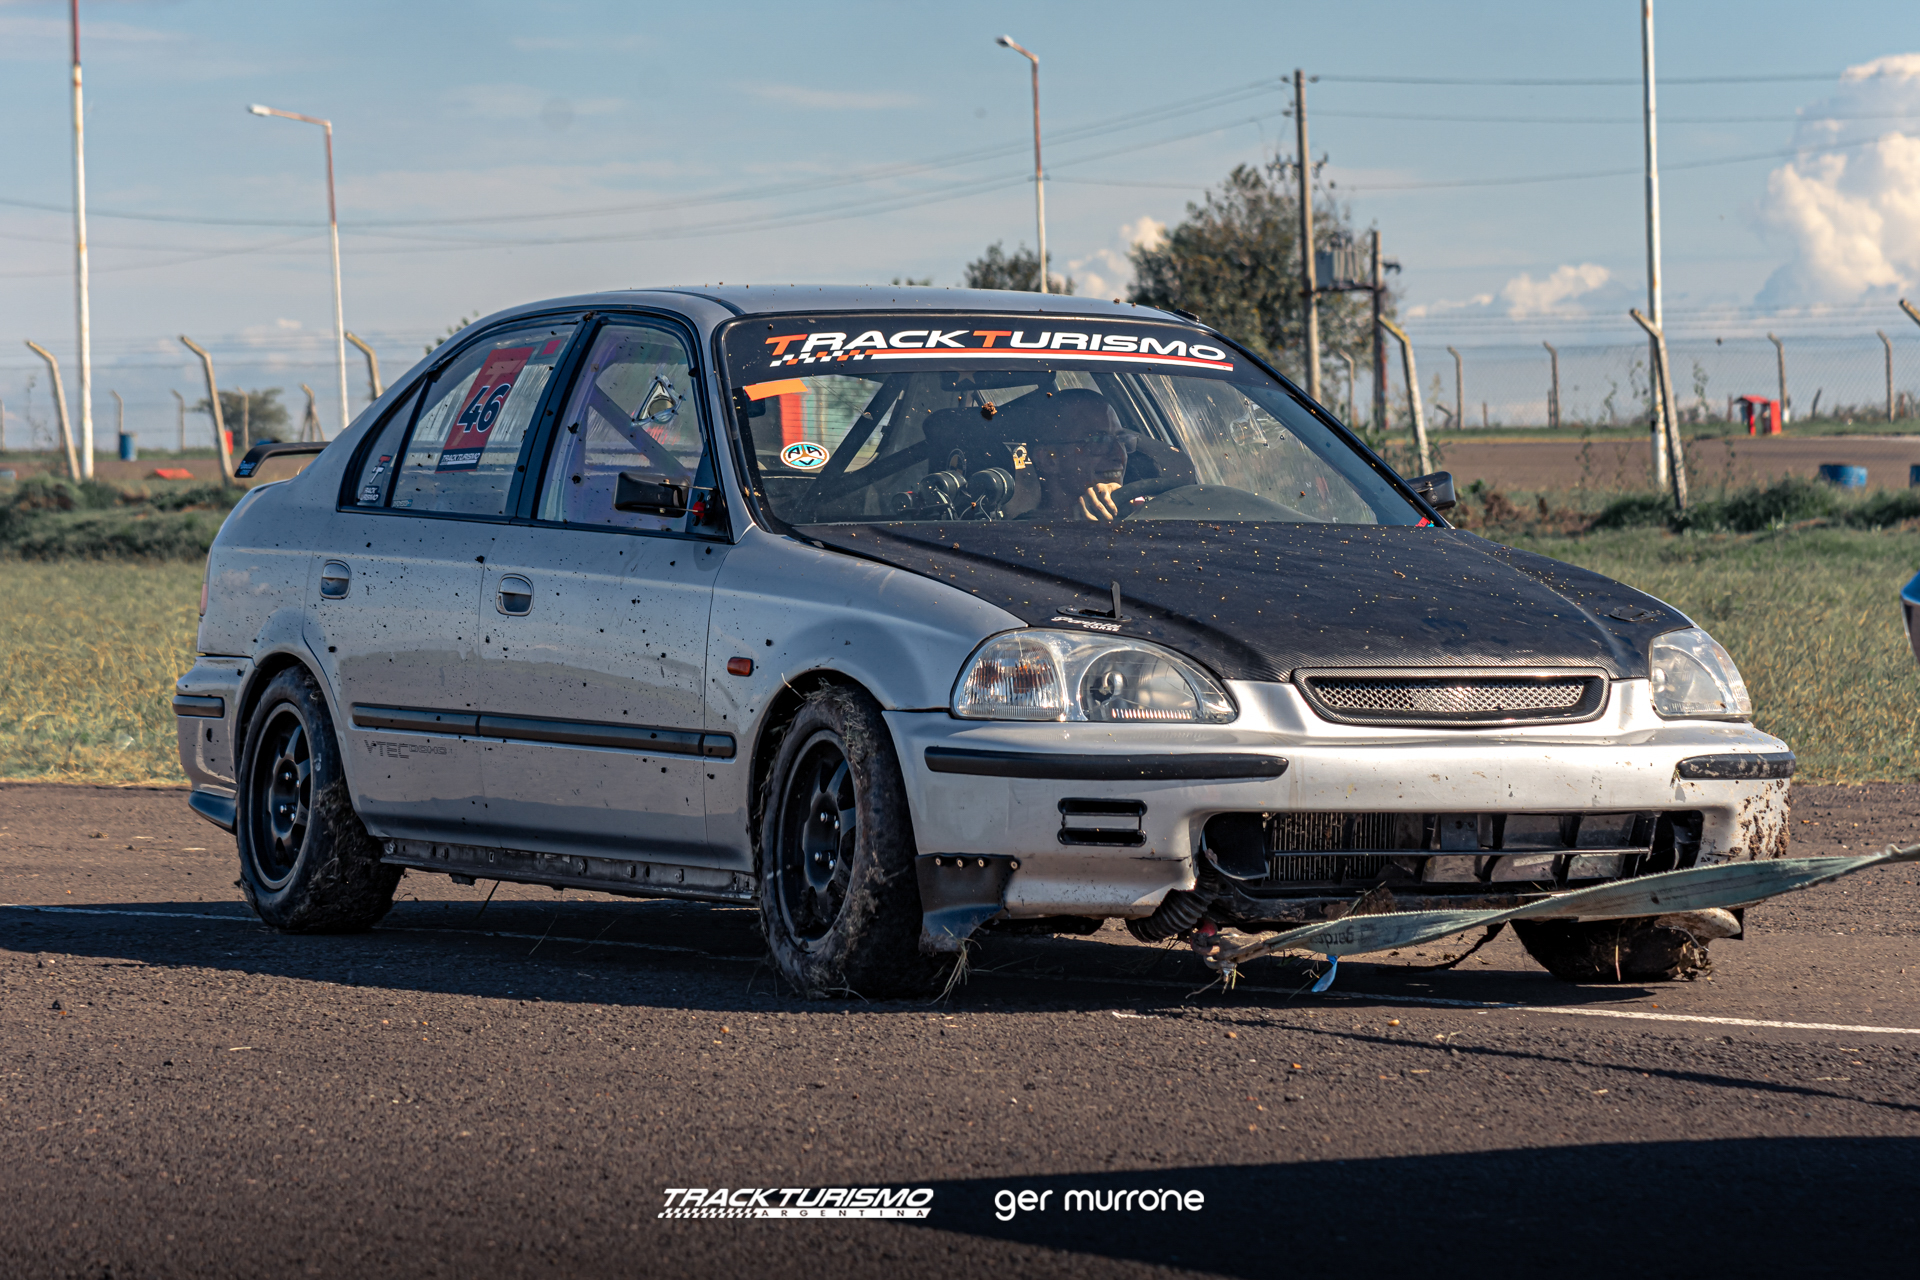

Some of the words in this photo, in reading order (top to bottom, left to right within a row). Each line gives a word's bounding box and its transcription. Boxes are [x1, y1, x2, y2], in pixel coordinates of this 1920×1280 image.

[765, 330, 970, 356] TRACK
[973, 330, 1226, 361] TURISMO
[457, 383, 511, 433] 46
[364, 740, 409, 759] VTEC
